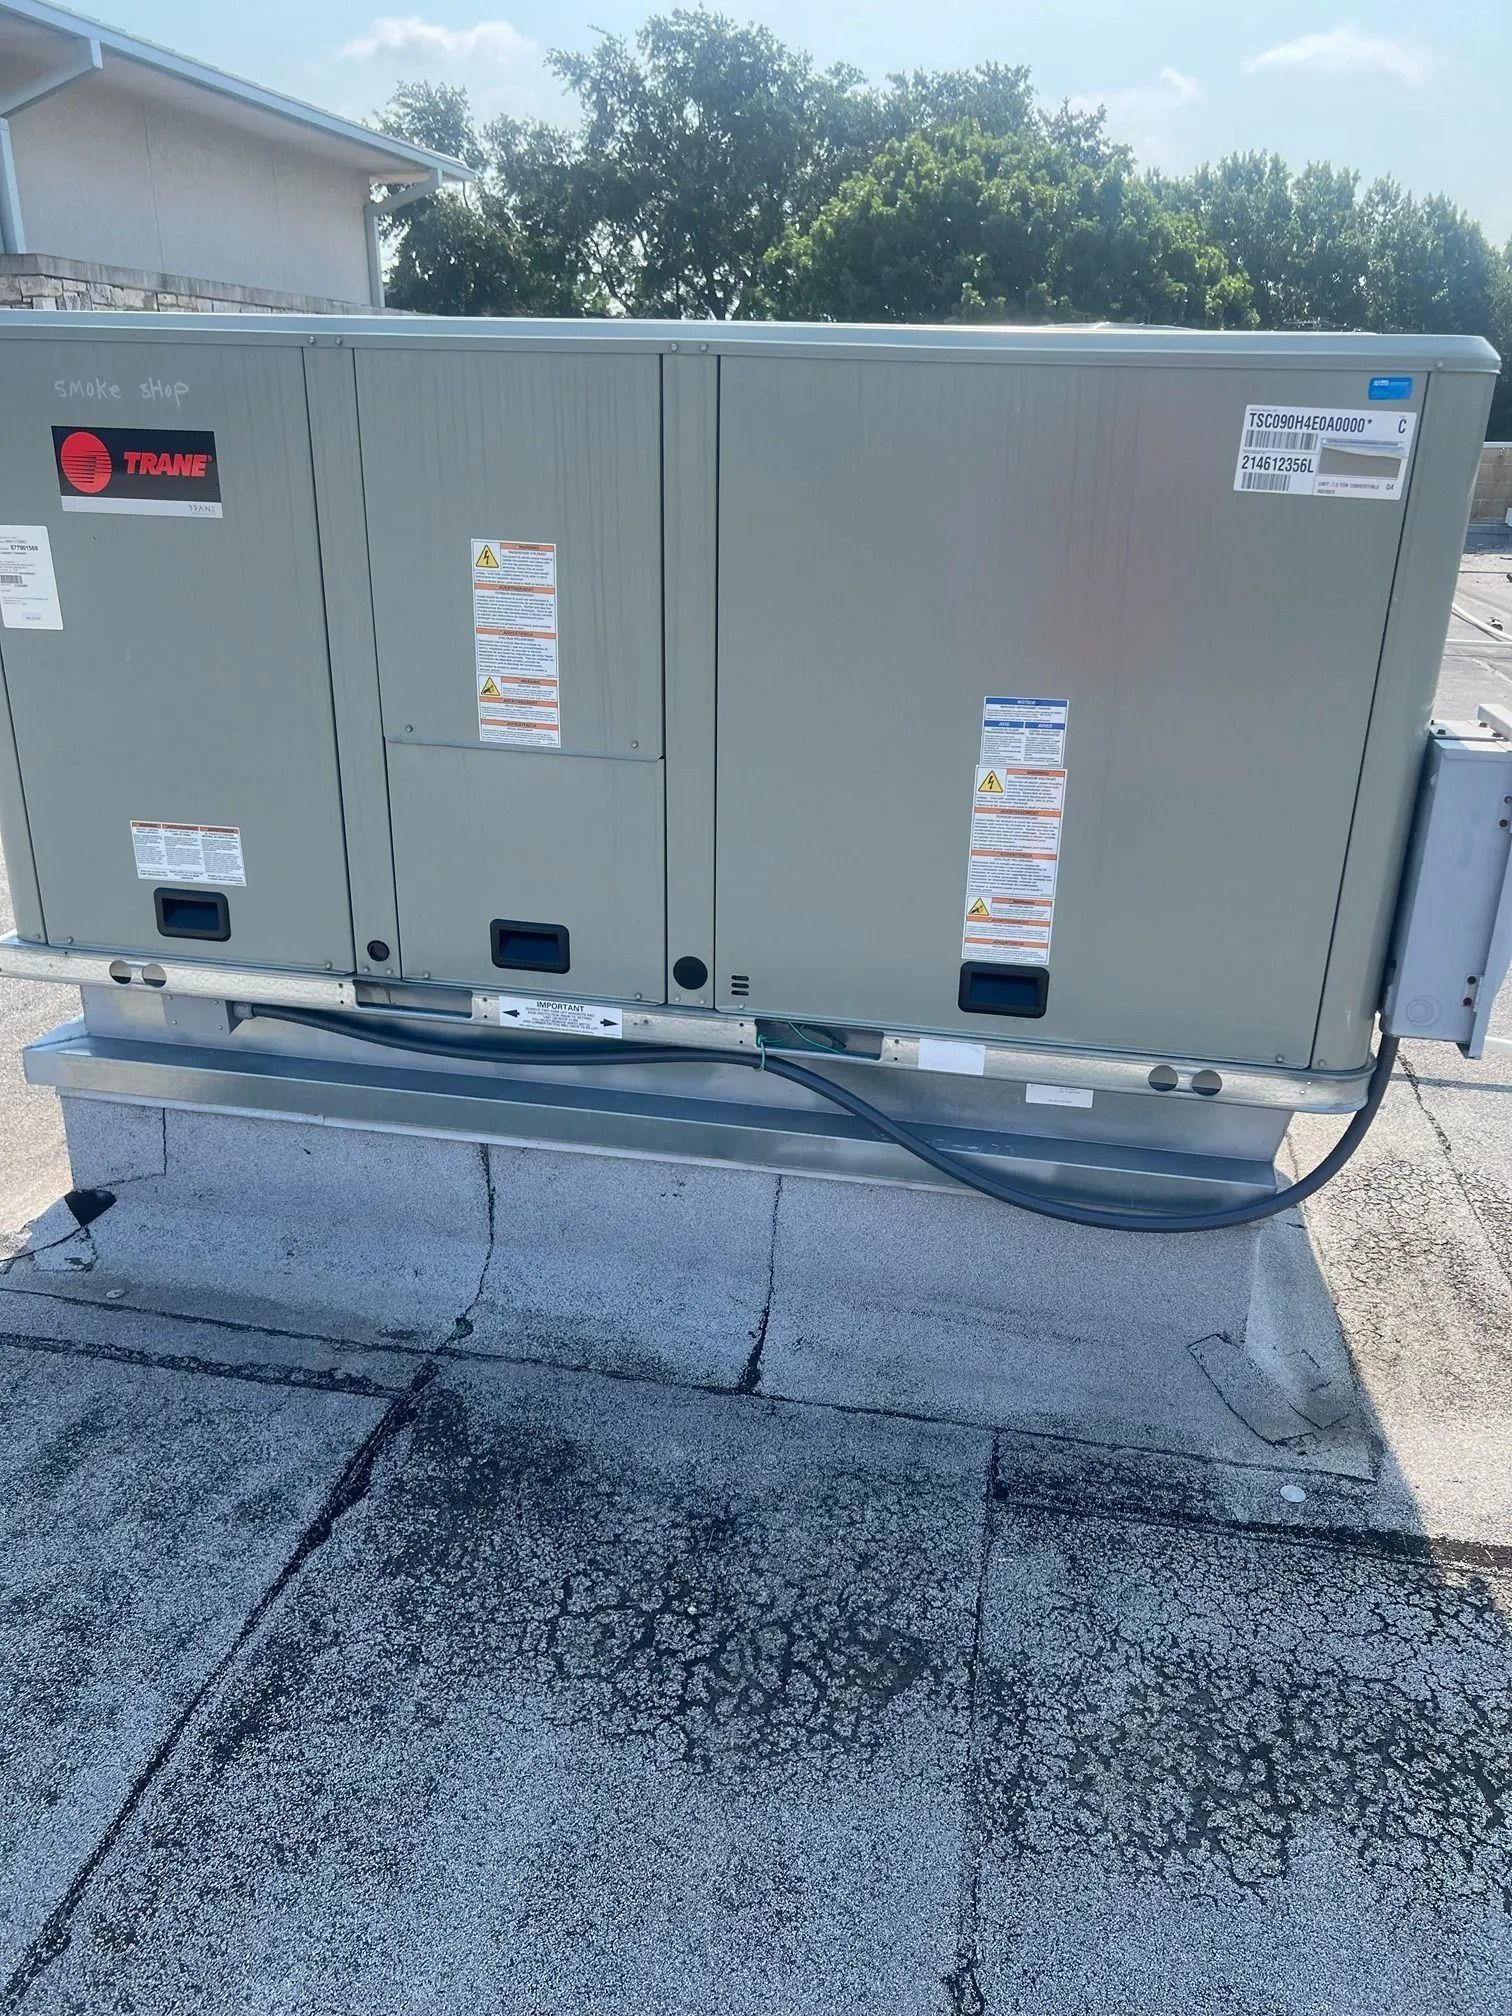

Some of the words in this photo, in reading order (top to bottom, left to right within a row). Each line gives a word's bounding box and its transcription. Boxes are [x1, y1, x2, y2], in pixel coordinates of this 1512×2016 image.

[1398, 418, 1407, 434] C
[123, 451, 208, 477] TRANE
[1241, 455, 1315, 473] 214612356L
[536, 1001, 585, 1012] IMPORTANT
